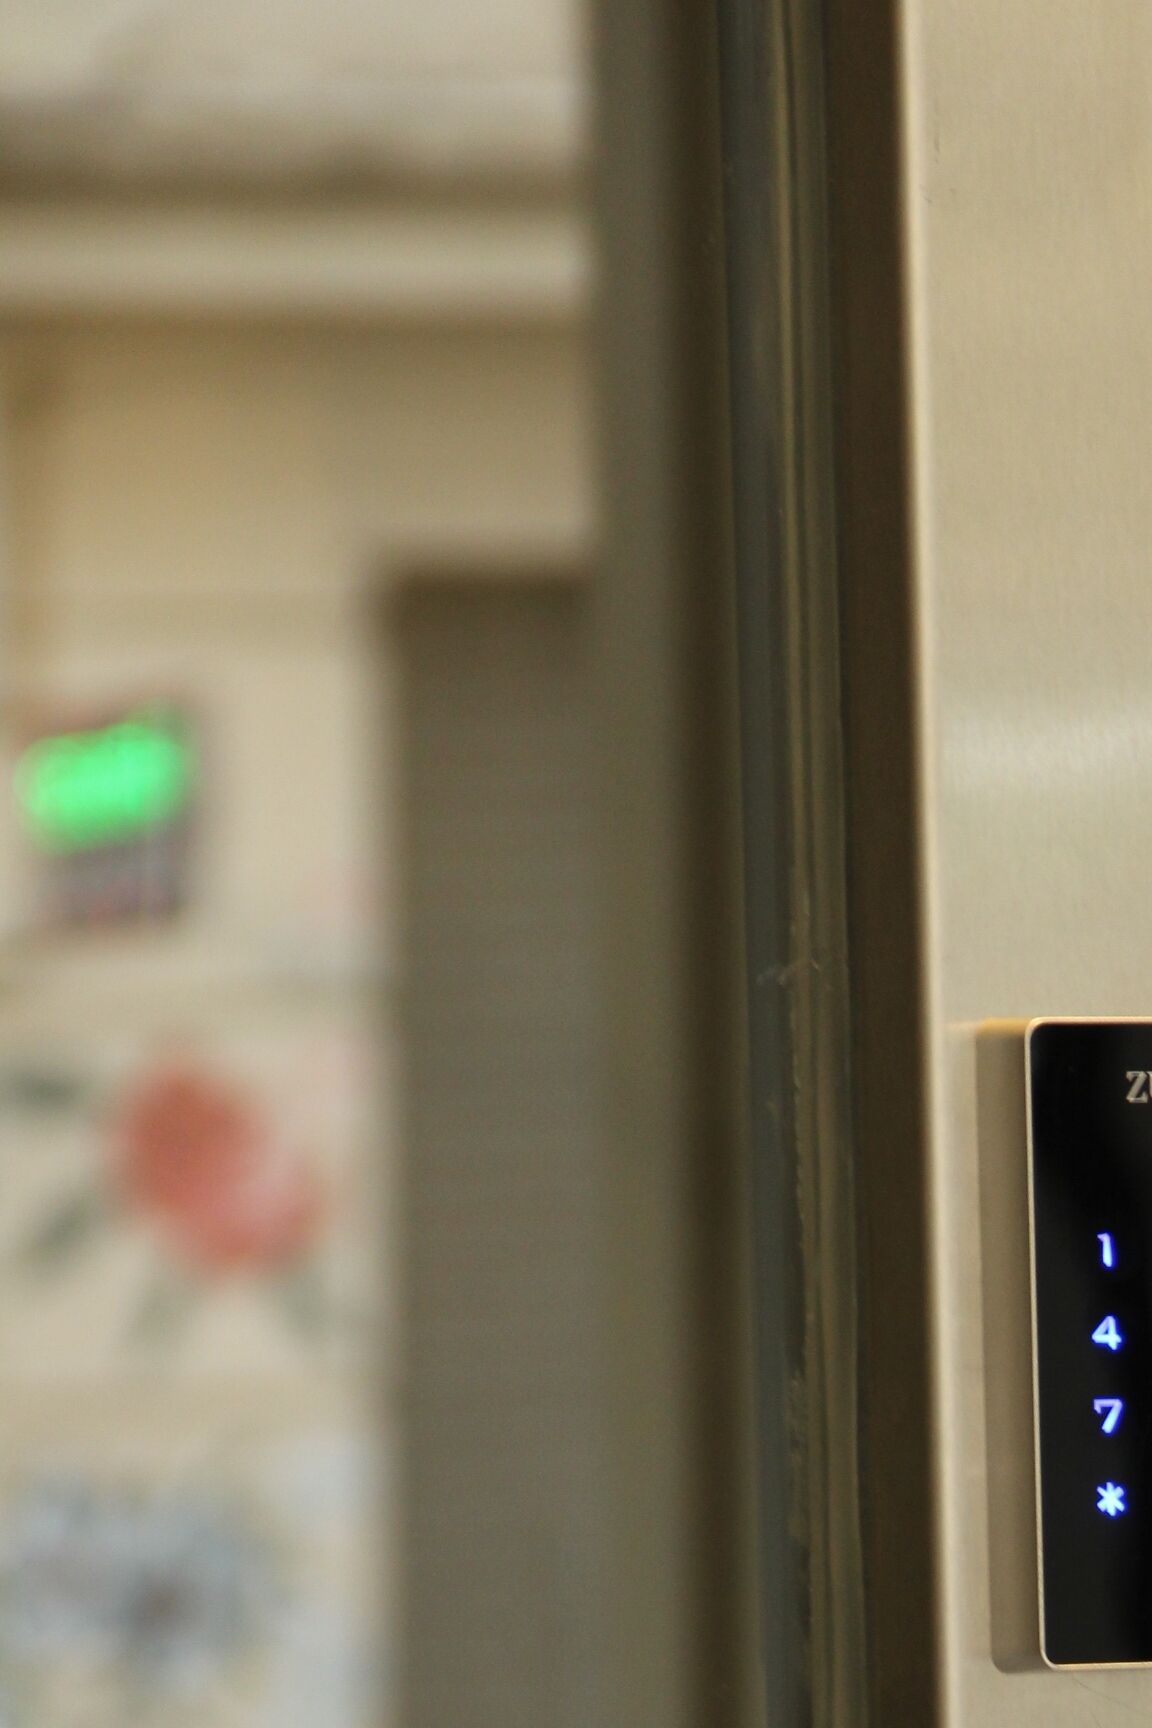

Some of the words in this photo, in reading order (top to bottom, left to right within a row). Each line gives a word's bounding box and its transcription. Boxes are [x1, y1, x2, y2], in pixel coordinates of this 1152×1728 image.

[1096, 1231, 1116, 1269] 1
[1091, 1313, 1124, 1352] 4
[1092, 1396, 1124, 1436] 7
